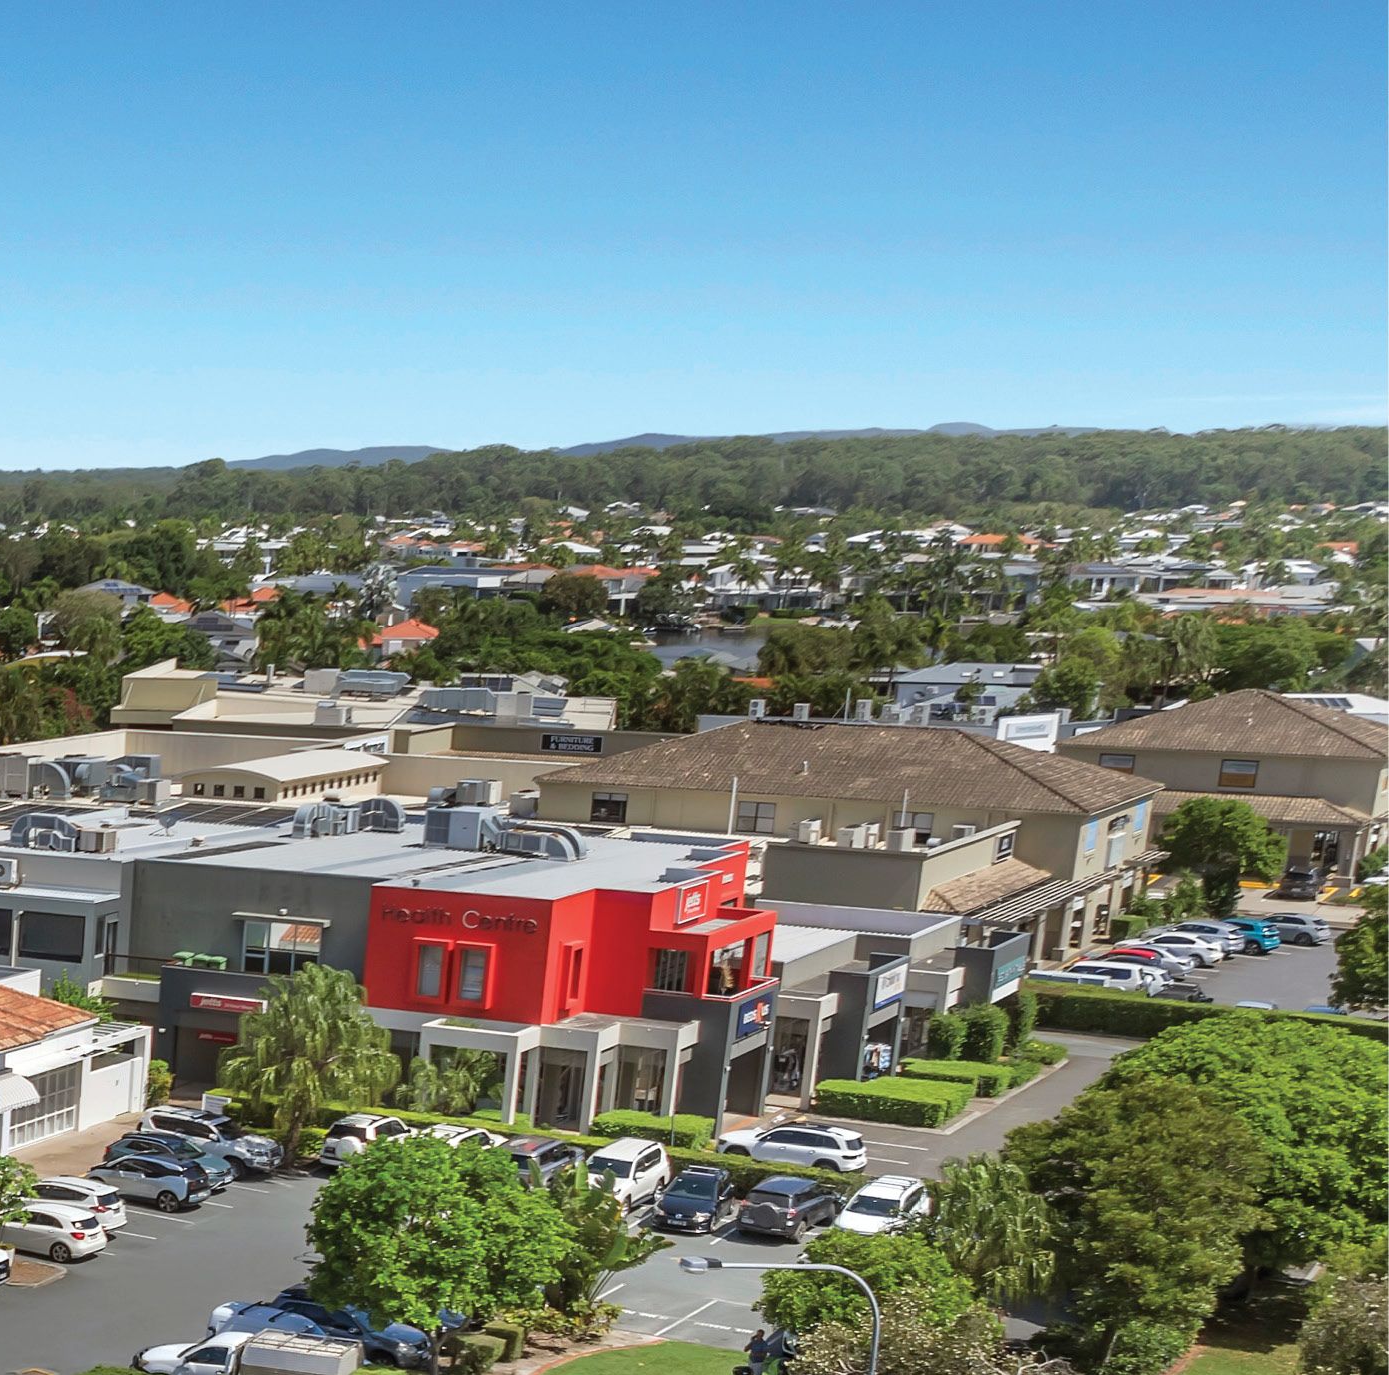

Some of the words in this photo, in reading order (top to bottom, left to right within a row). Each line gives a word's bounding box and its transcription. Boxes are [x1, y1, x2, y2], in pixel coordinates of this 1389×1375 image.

[550, 735, 594, 745] FURNITURE
[558, 743, 594, 751] BEDDING
[381, 903, 452, 926] Health
[462, 909, 538, 934] Centre
